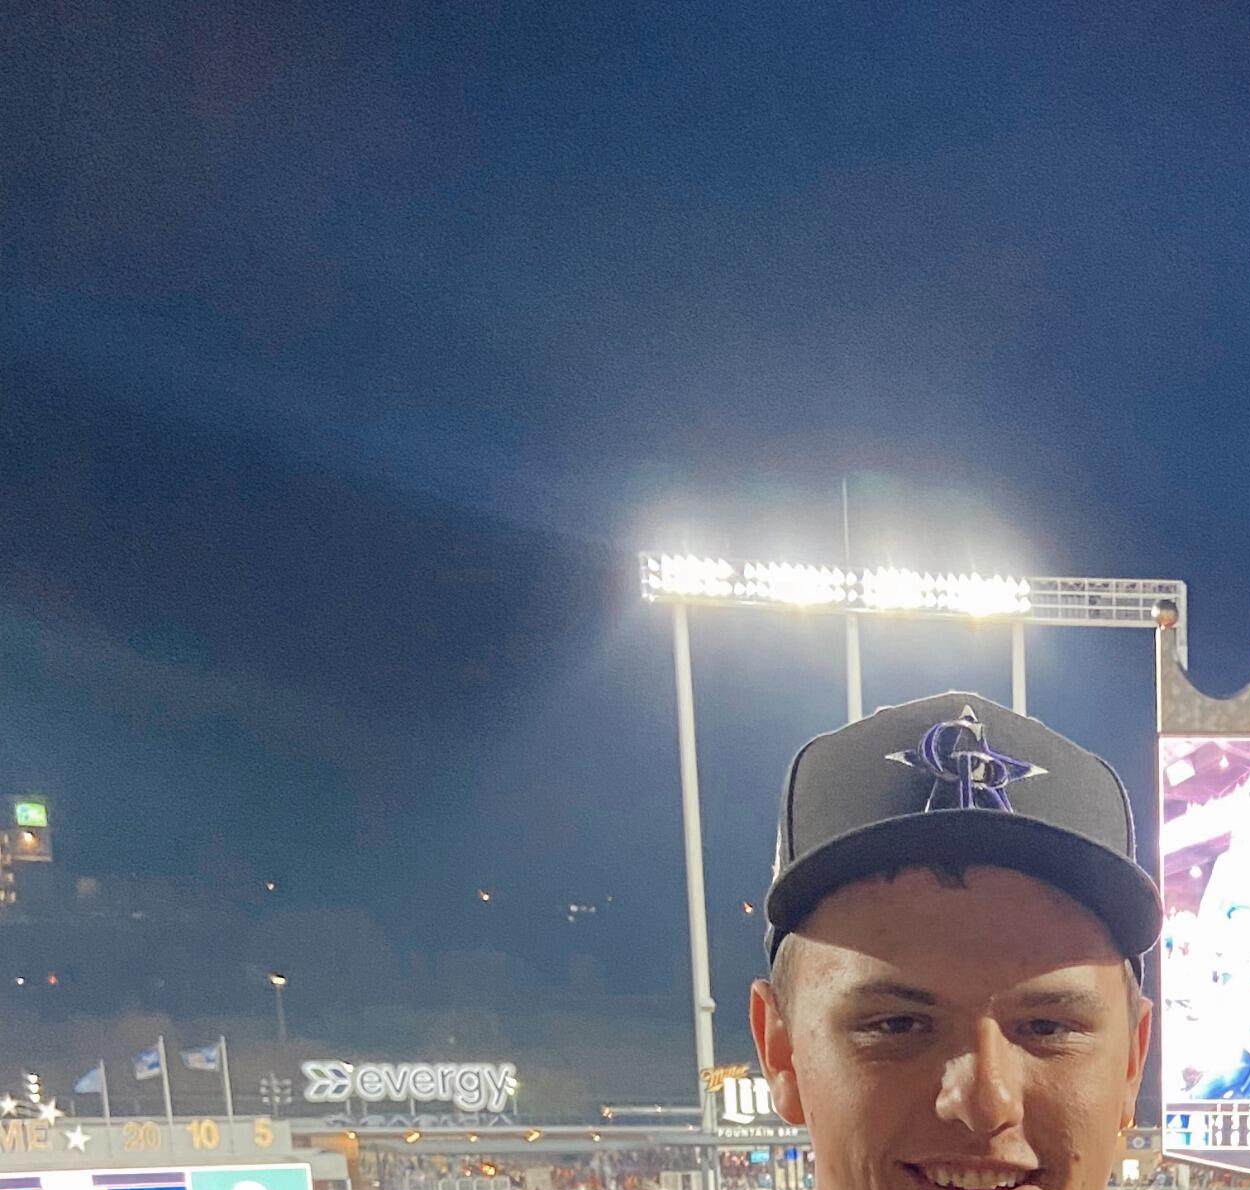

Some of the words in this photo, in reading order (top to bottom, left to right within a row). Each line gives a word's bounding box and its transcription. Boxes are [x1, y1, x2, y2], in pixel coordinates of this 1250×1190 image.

[356, 1063, 515, 1112] evergy
[723, 1077, 772, 1124] Lit
[122, 1121, 161, 1151] 20
[186, 1119, 220, 1149] 10
[254, 1117, 273, 1148] 5
[718, 1127, 775, 1138] FOUNTAIN
[778, 1127, 799, 1138] BAR
